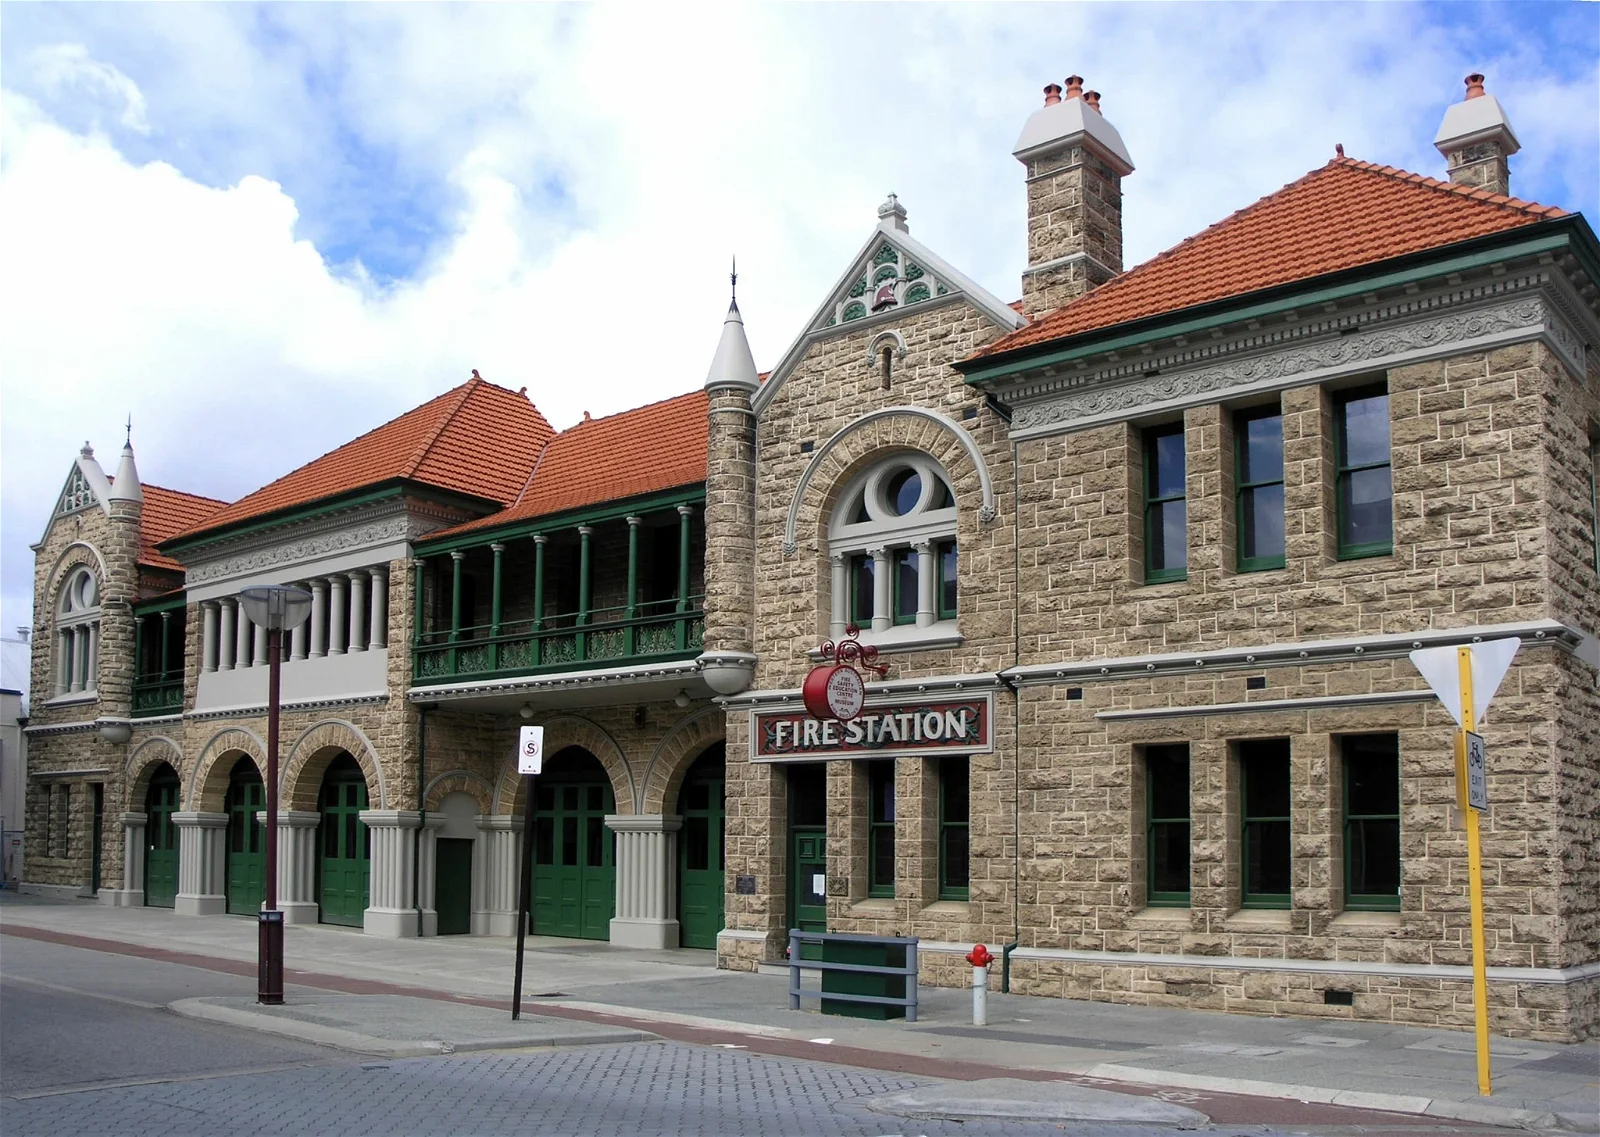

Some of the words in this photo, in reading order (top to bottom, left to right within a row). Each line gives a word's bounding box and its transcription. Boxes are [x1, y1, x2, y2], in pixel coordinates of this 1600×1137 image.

[832, 685, 858, 693] EDUCATION
[775, 719, 839, 747] FIRE
[844, 710, 966, 743] STATION
[526, 743, 535, 754] S
[1471, 774, 1482, 787] EXIT
[1471, 789, 1483, 801] ONLY
